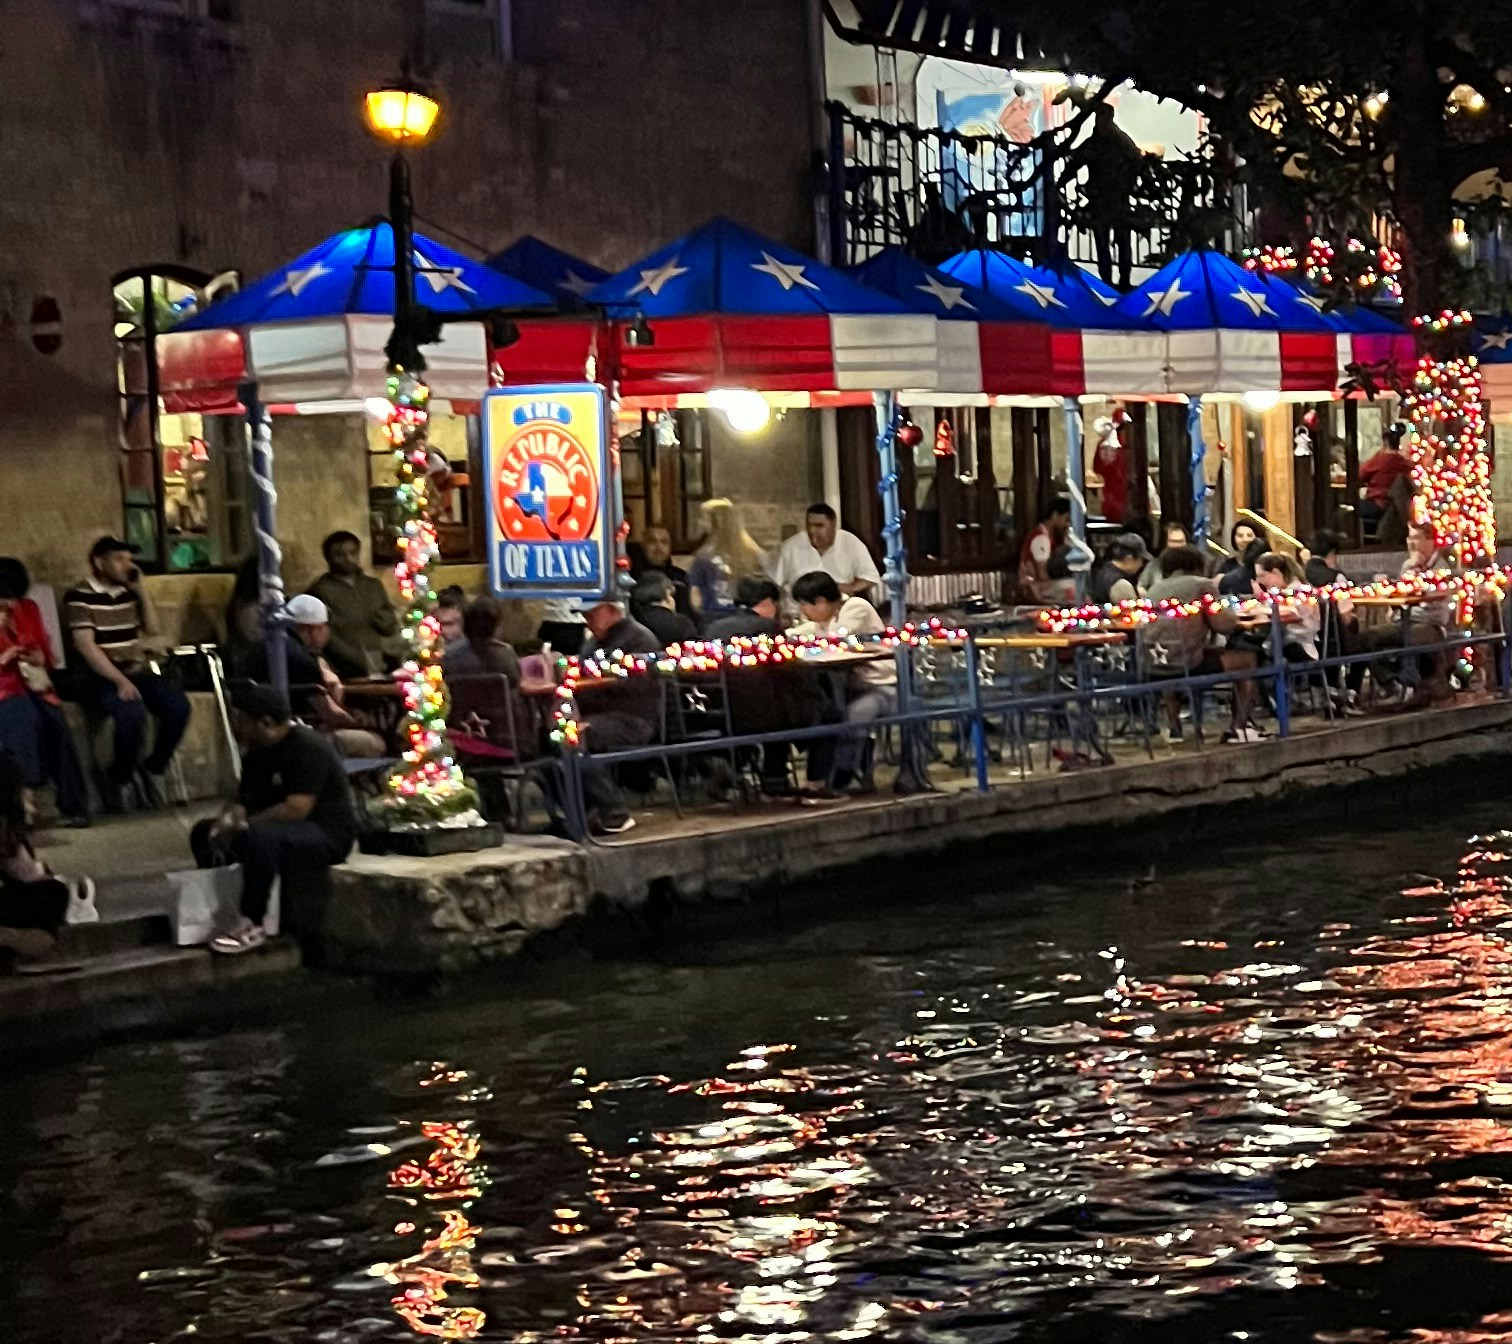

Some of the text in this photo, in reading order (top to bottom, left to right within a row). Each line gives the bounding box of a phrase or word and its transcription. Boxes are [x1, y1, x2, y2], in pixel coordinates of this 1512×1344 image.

[523, 401, 562, 419] THE
[500, 432, 589, 487] REPUBLIC
[504, 543, 592, 578] OF TEXAS
